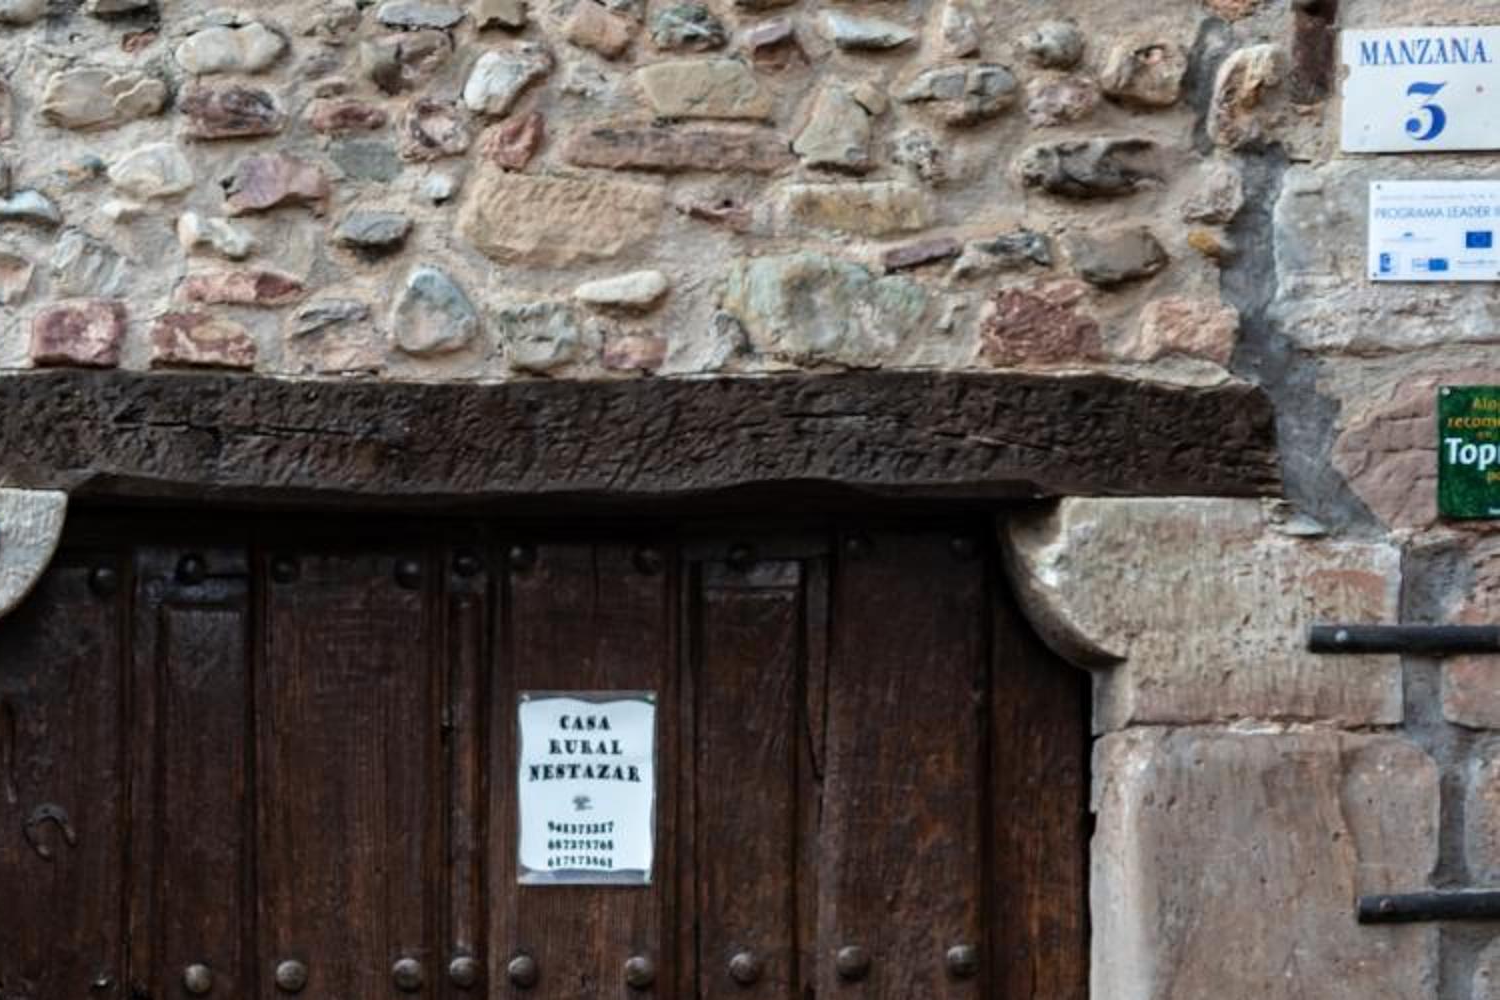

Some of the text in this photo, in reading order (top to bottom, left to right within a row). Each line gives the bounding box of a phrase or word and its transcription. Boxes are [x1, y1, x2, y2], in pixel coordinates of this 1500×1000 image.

[1405, 80, 1447, 141] 3
[1447, 205, 1491, 218] LEADER
[1444, 437, 1500, 471] Top
[559, 715, 611, 731] CASA
[549, 739, 623, 755] RURAL
[529, 764, 641, 782] NESTAZAR
